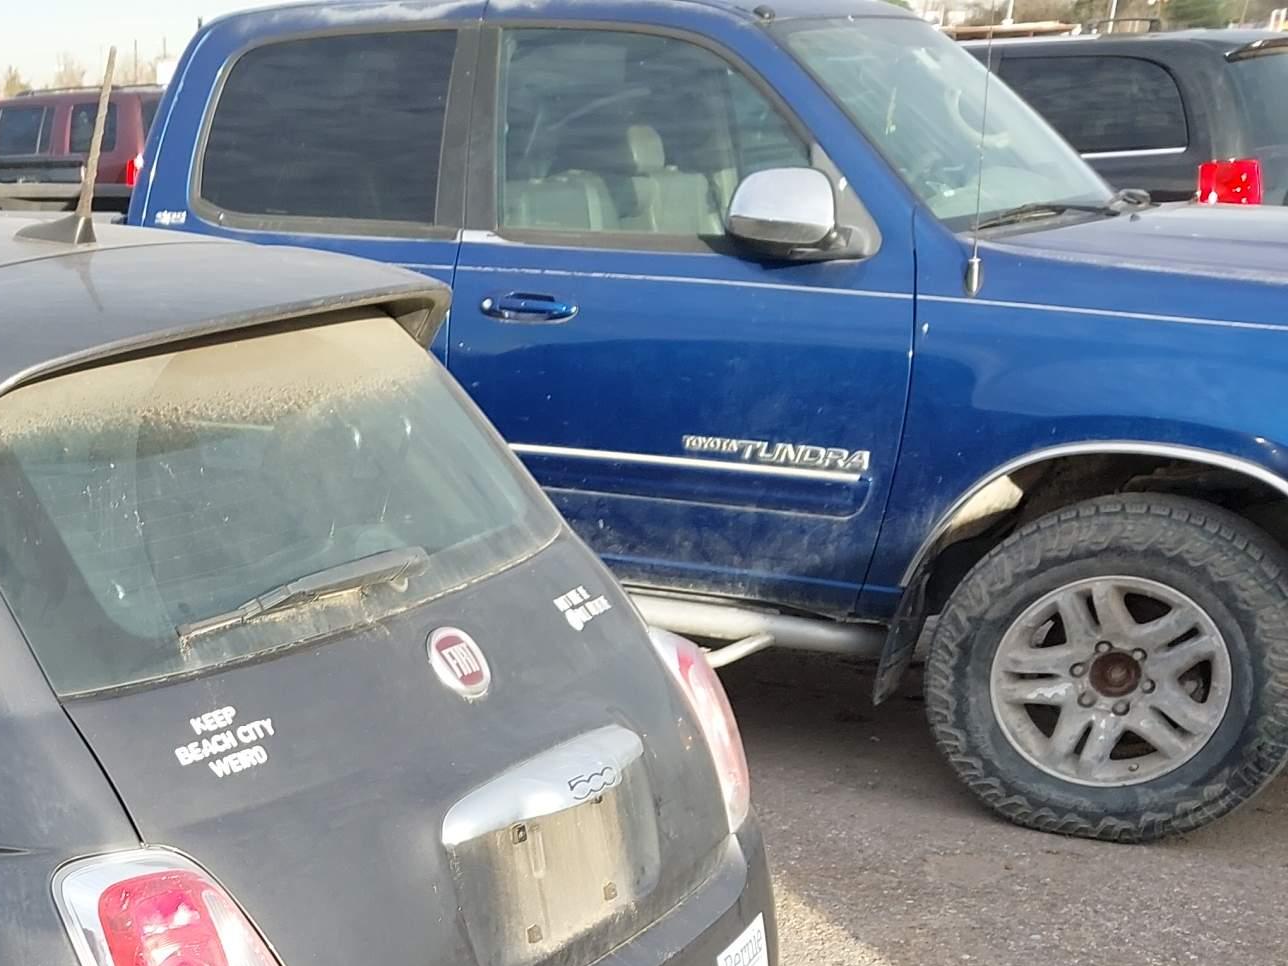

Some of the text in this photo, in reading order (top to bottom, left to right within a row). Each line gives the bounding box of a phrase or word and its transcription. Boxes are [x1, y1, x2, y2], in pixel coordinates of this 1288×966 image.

[683, 434, 871, 471] TOYOTA TUNDRA
[440, 642, 481, 680] FIAT
[189, 705, 236, 735] KEEP
[174, 717, 274, 766] BEACH CITY
[208, 744, 268, 778] WEIRD
[567, 765, 617, 801] 500
